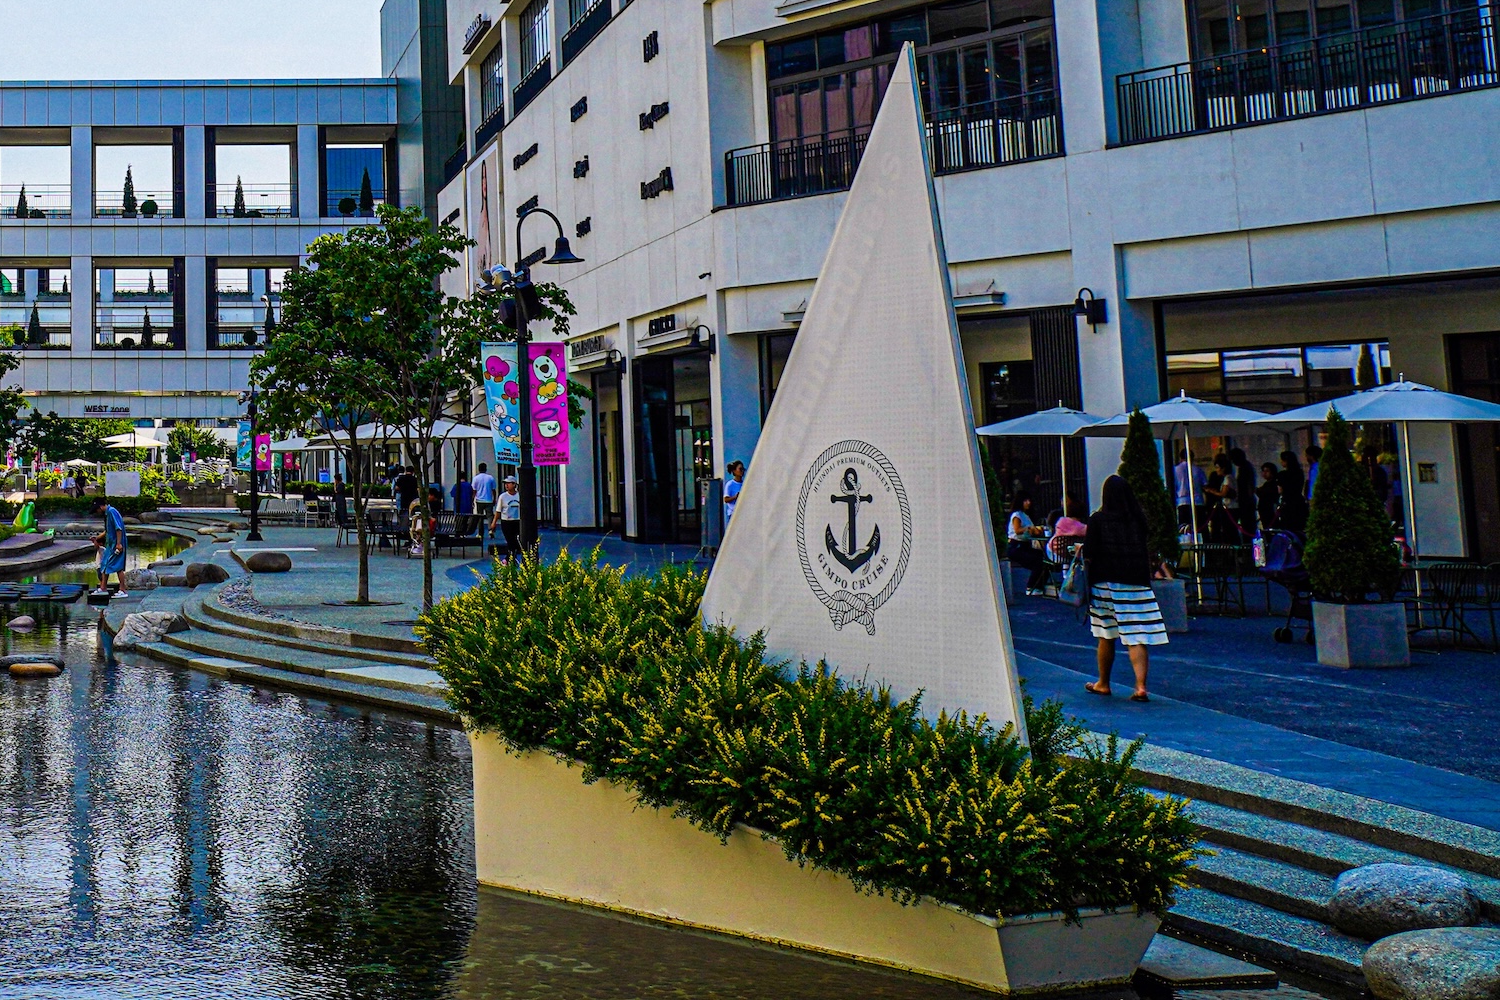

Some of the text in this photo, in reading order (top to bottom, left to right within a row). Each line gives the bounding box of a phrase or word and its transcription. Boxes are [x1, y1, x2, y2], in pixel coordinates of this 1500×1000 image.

[84, 404, 109, 413] WEST
[813, 456, 892, 493] HYUNDAI PREMIUM OUTLETS
[817, 553, 889, 591] GIMPO CRUISE
